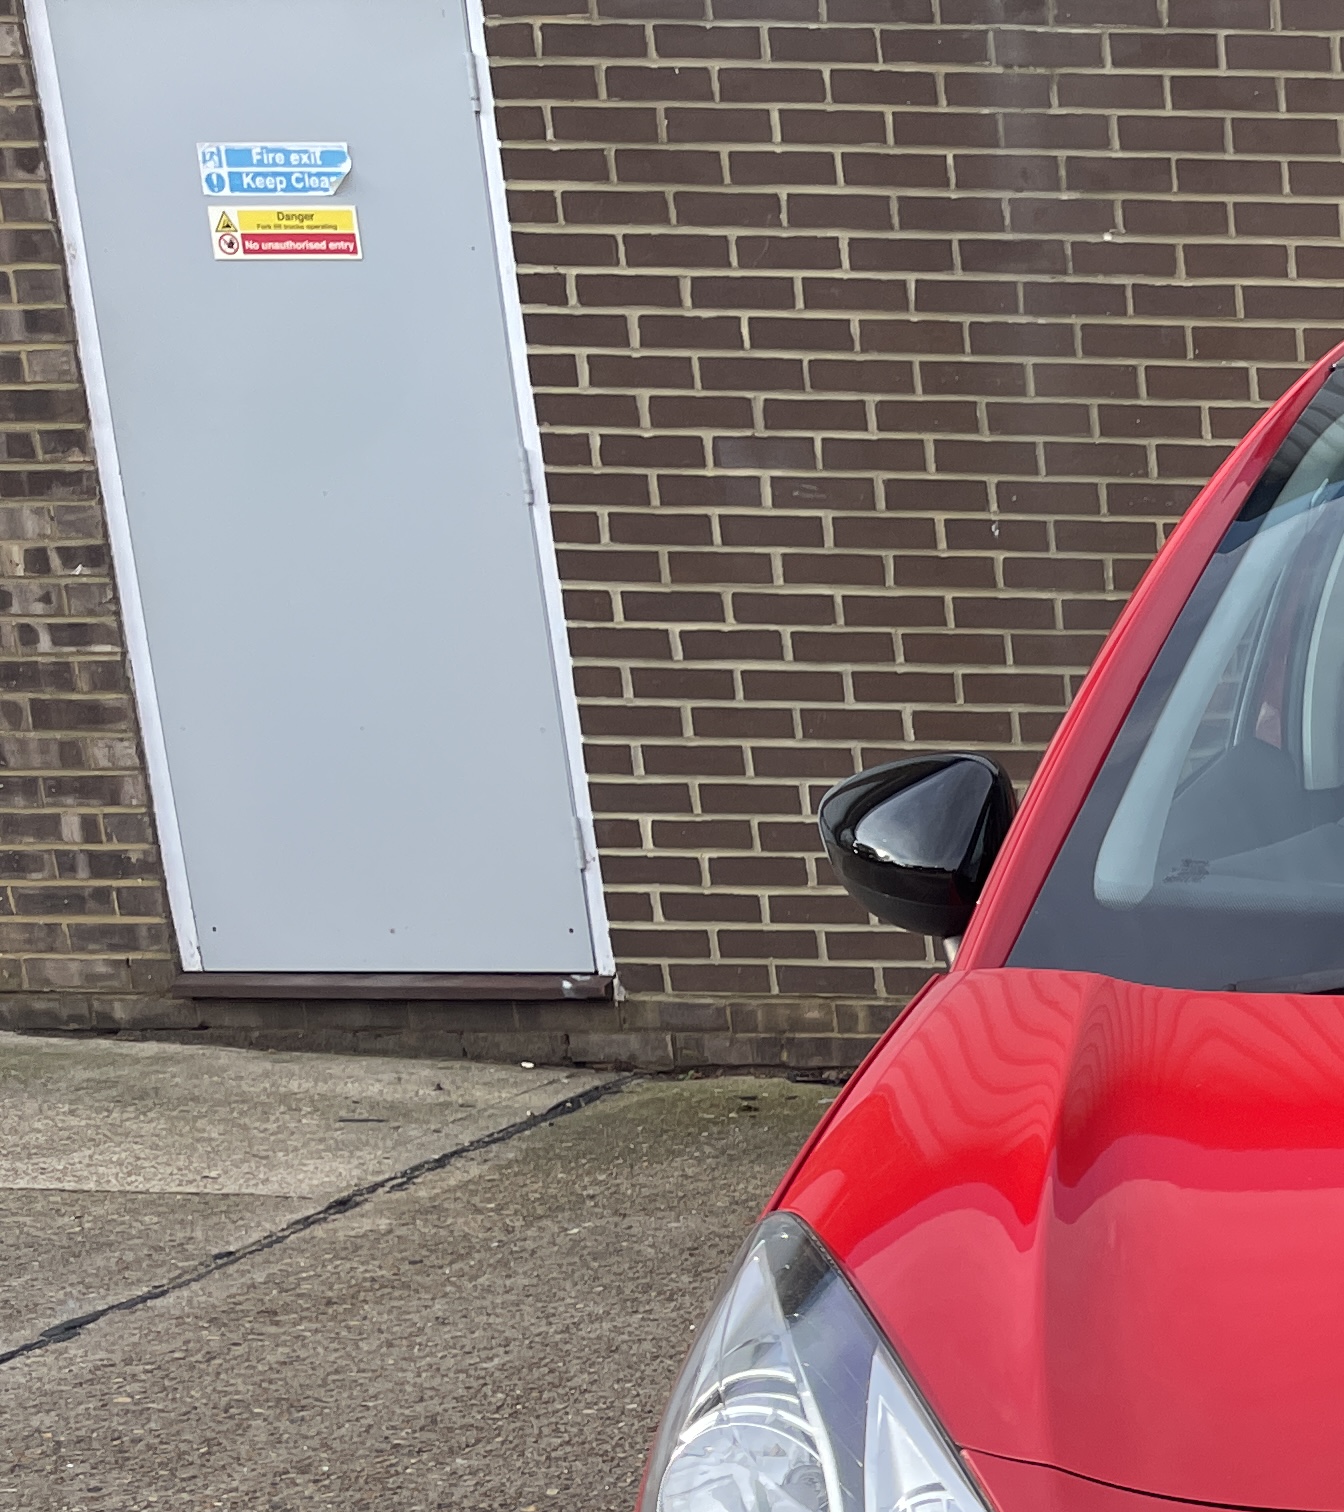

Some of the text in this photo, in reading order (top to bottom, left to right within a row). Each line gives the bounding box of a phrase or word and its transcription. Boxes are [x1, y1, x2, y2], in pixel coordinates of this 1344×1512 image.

[252, 149, 323, 165] Fire exit
[242, 173, 287, 191] Keep
[276, 211, 315, 223] Danger
[244, 239, 355, 252] No unauthorised entry
